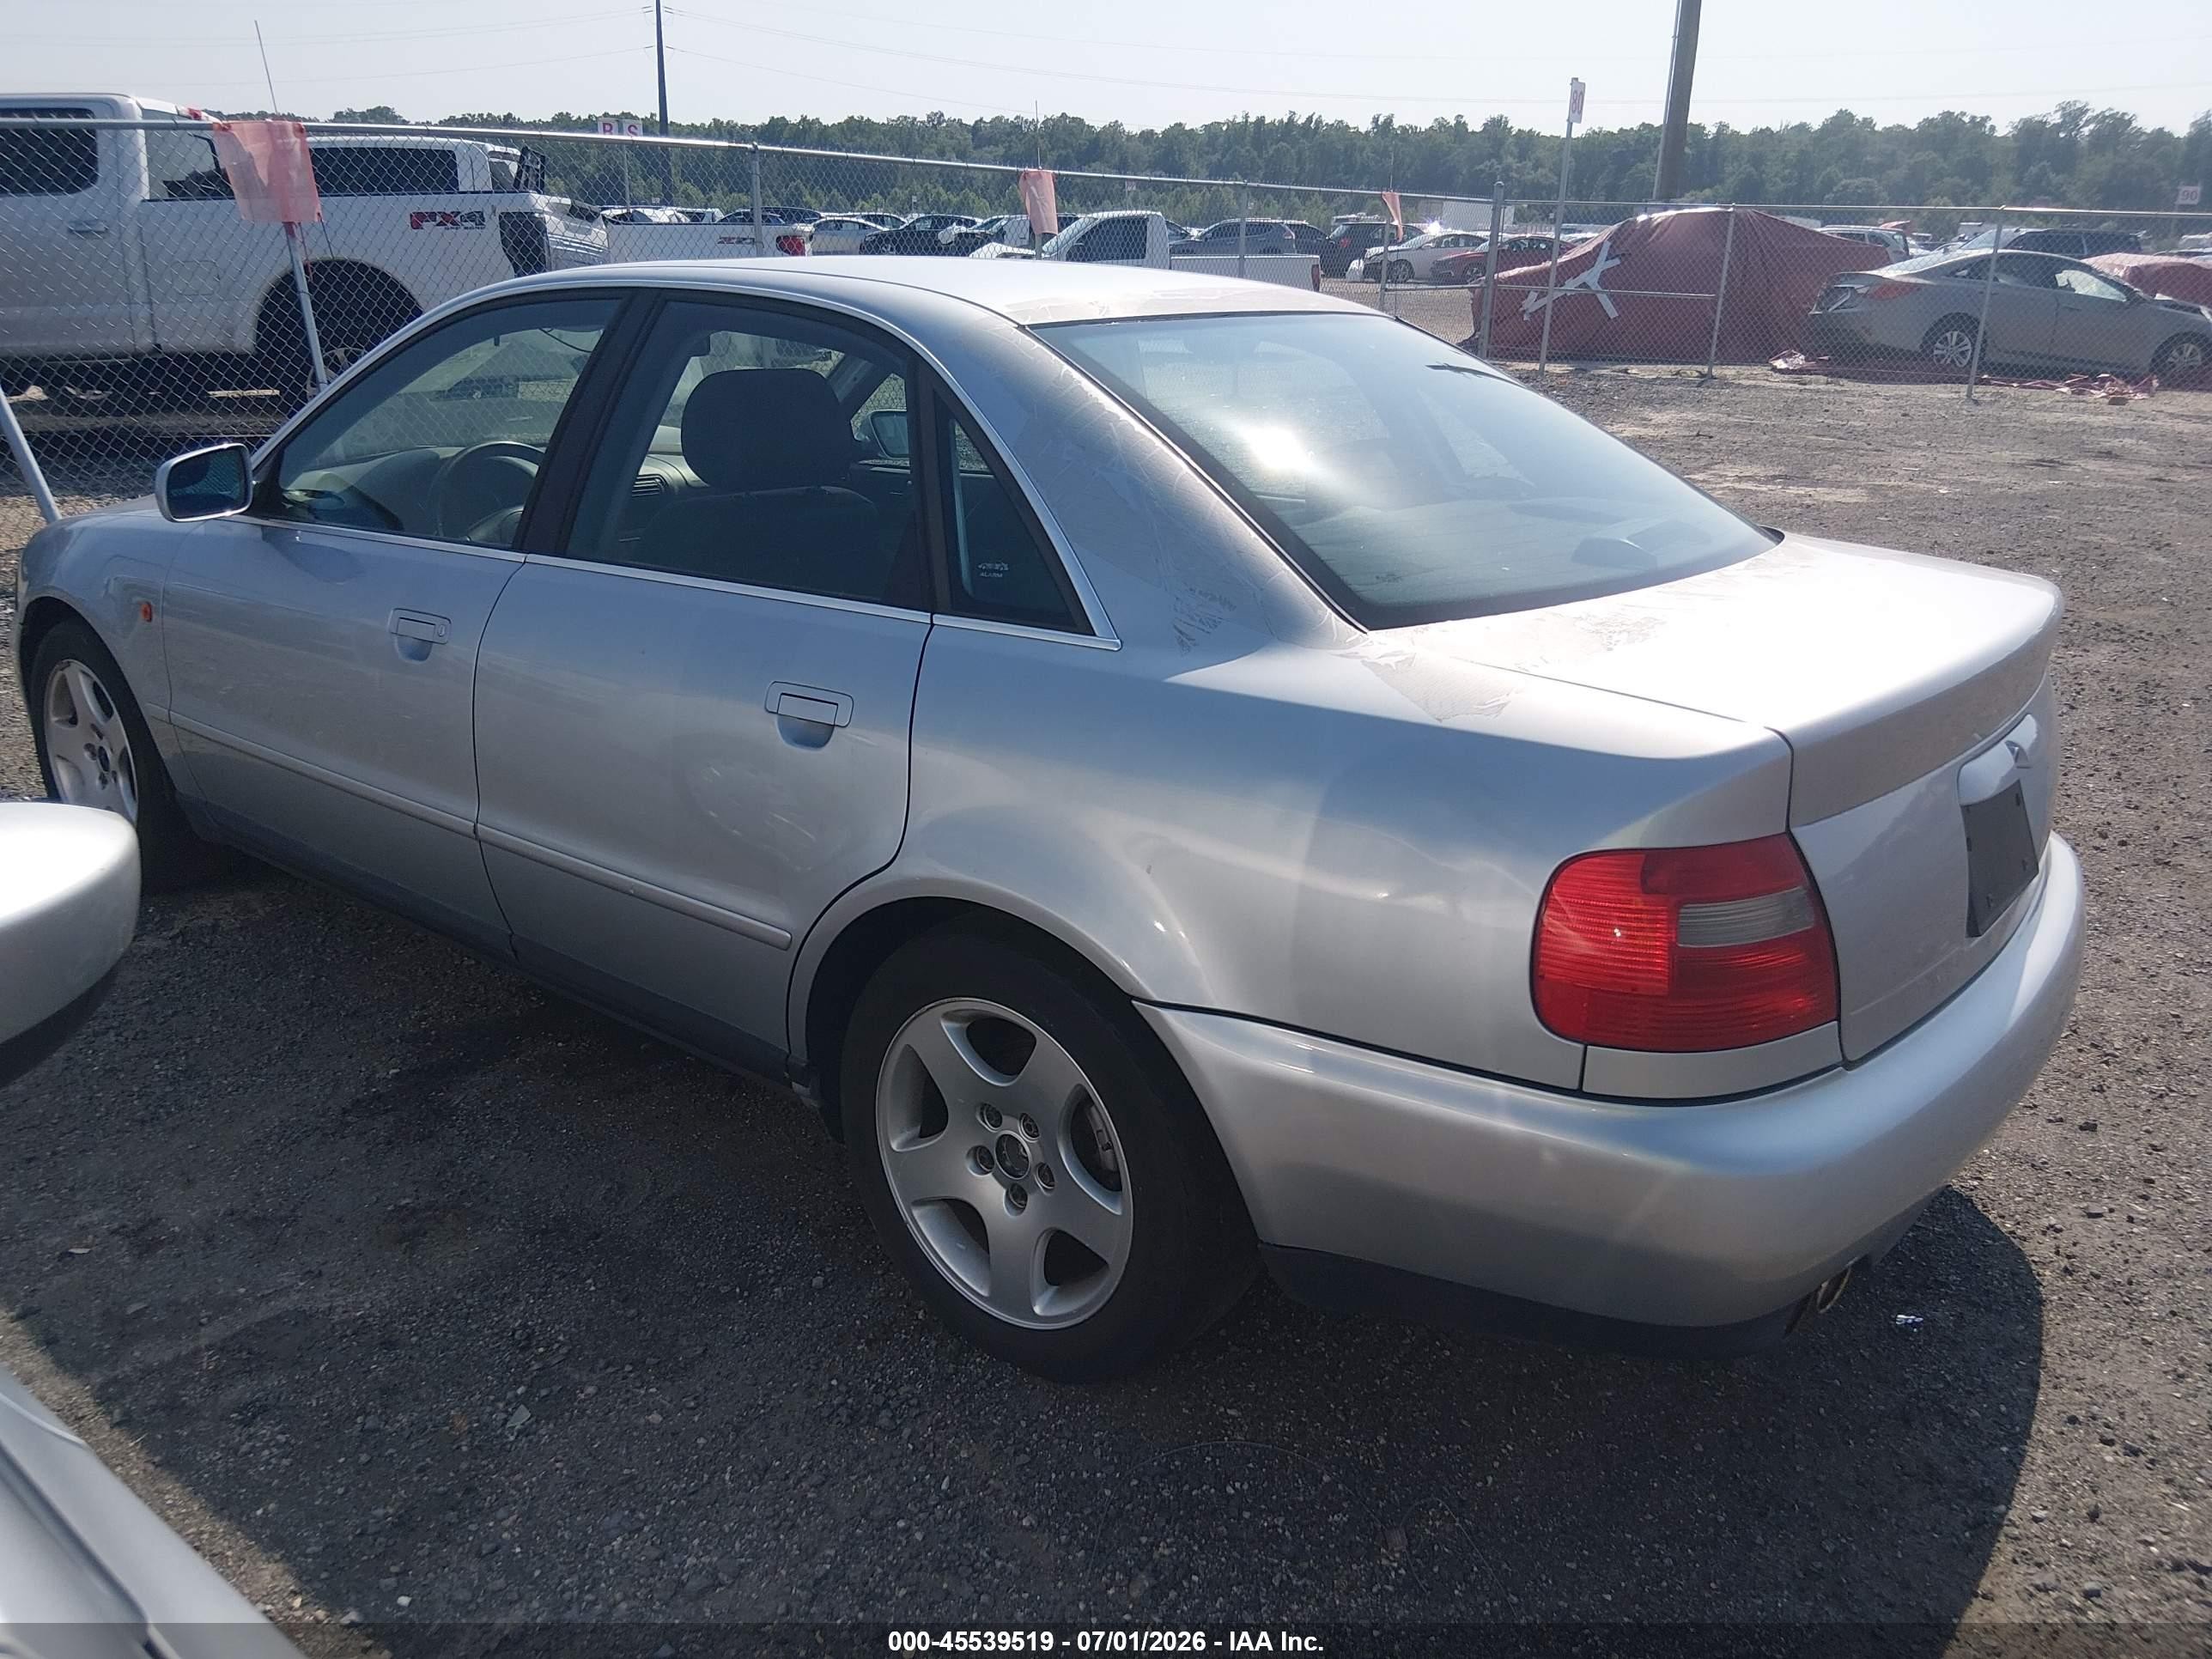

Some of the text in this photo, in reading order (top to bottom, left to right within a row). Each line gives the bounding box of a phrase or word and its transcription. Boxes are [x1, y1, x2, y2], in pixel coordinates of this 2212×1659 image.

[1571, 89, 1583, 116] 80
[2181, 190, 2198, 201] 90
[410, 210, 485, 229] FX4
